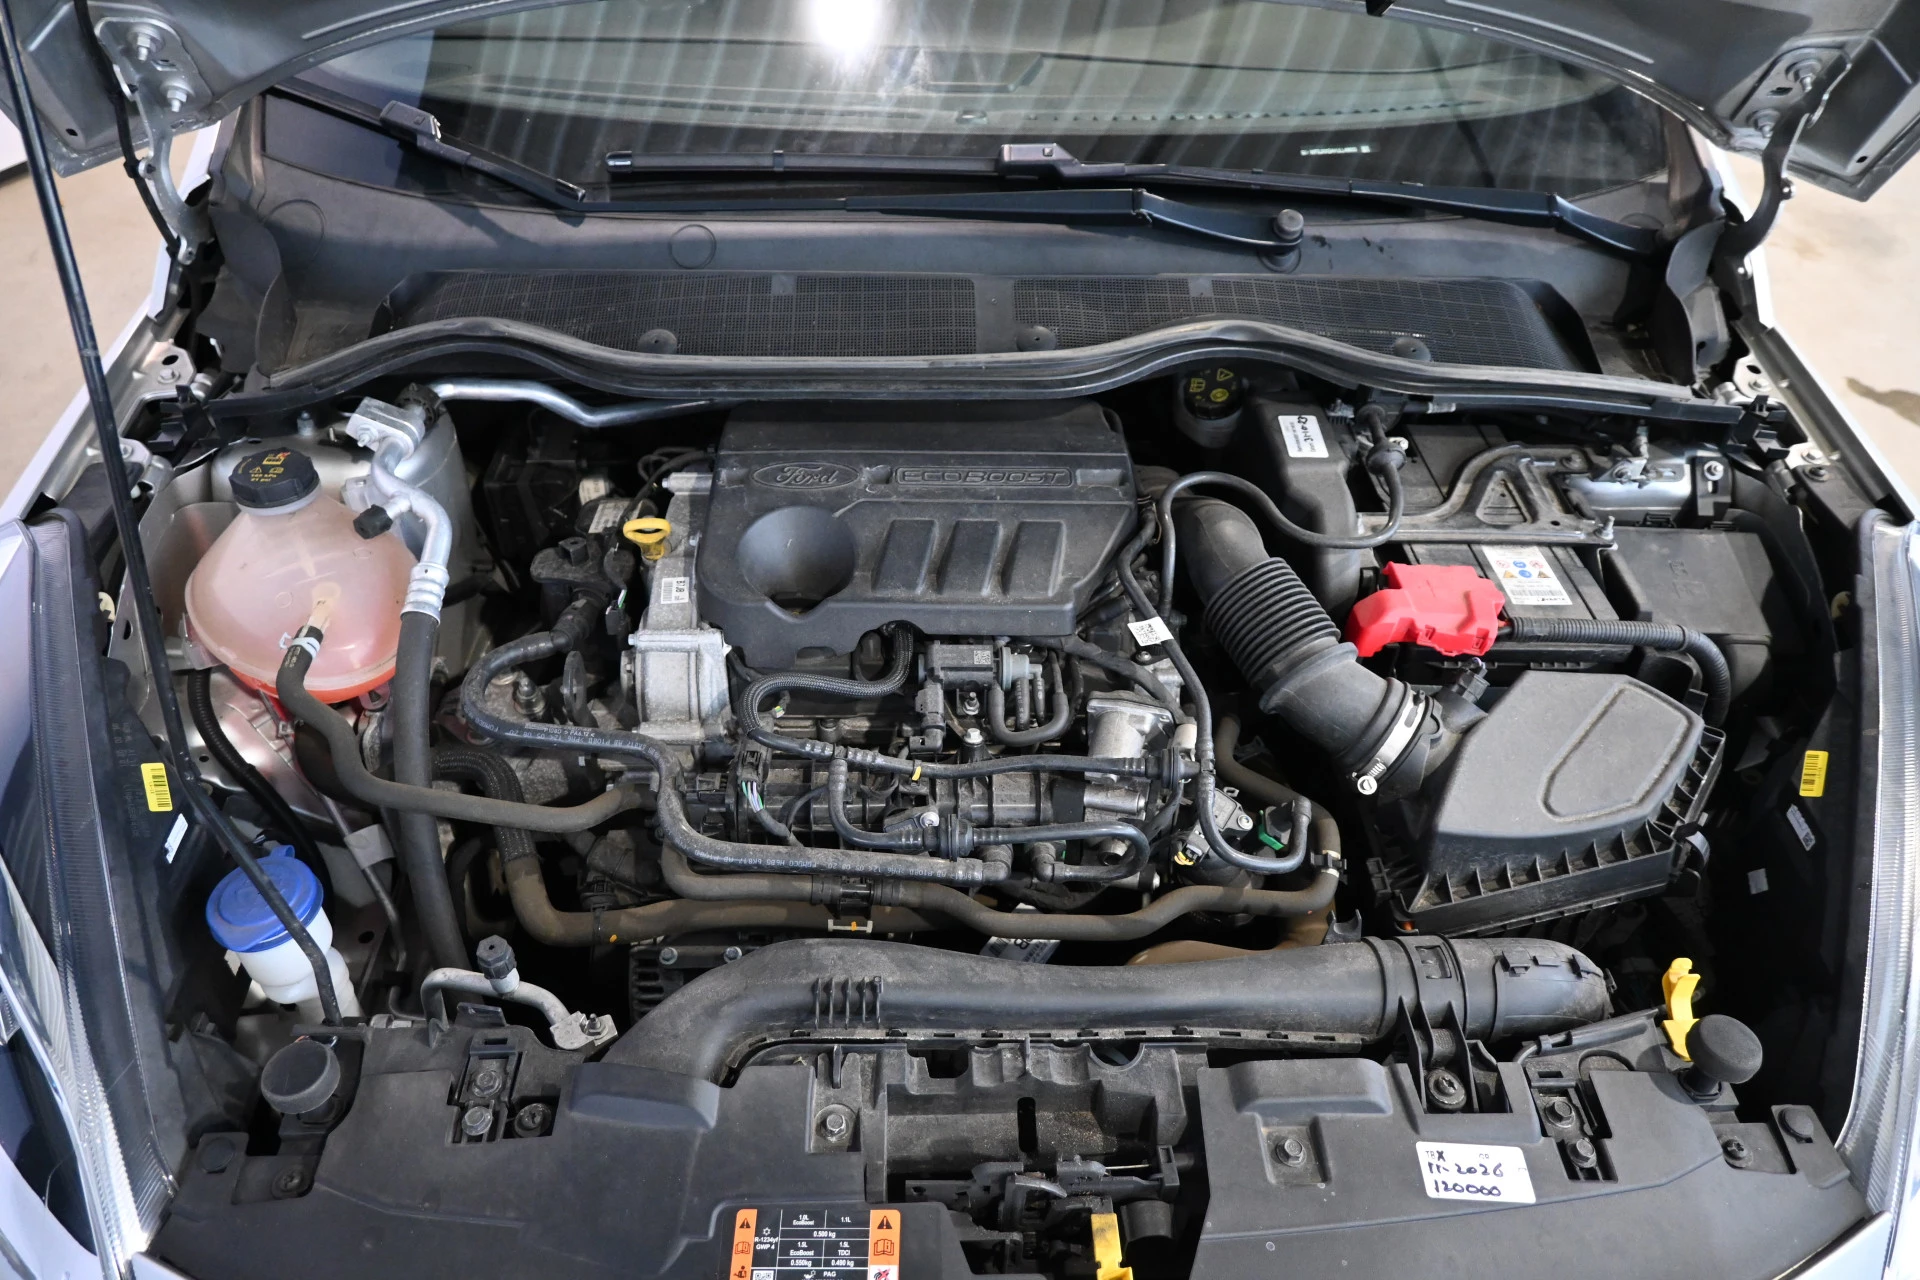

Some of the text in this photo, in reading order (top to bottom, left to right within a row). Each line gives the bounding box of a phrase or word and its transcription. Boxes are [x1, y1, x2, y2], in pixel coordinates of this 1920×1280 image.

[776, 466, 838, 484] Ford
[1434, 1179, 1501, 1197] 120000
[828, 1230, 836, 1239] kg
[754, 1236, 778, 1244] R-1234yf
[789, 1249, 815, 1257] EcoBoost
[847, 1259, 855, 1268] kg
